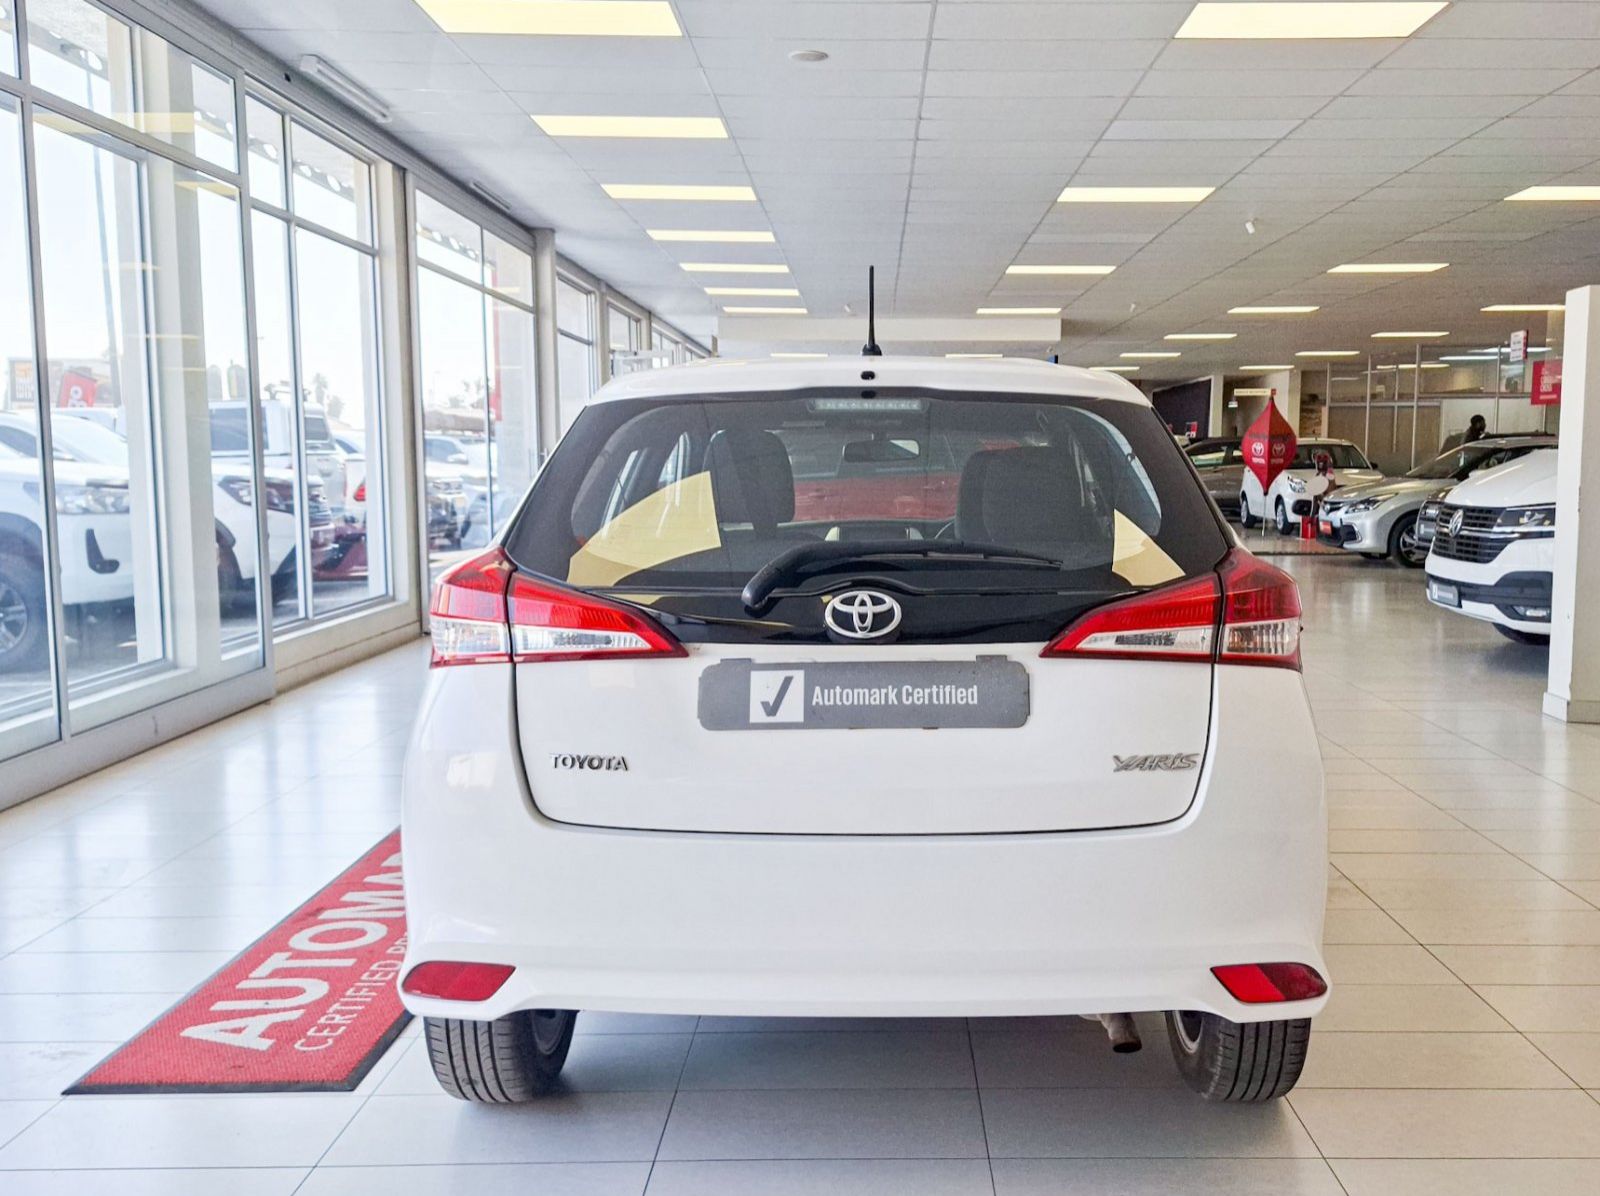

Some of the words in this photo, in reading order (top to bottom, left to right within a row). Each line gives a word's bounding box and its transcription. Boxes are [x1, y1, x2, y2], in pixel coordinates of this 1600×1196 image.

[812, 685, 899, 706] Automark
[901, 684, 979, 705] Certified
[549, 753, 629, 771] TOYOTA
[1112, 753, 1200, 772] YARIS
[294, 959, 402, 1052] CERTIFIED
